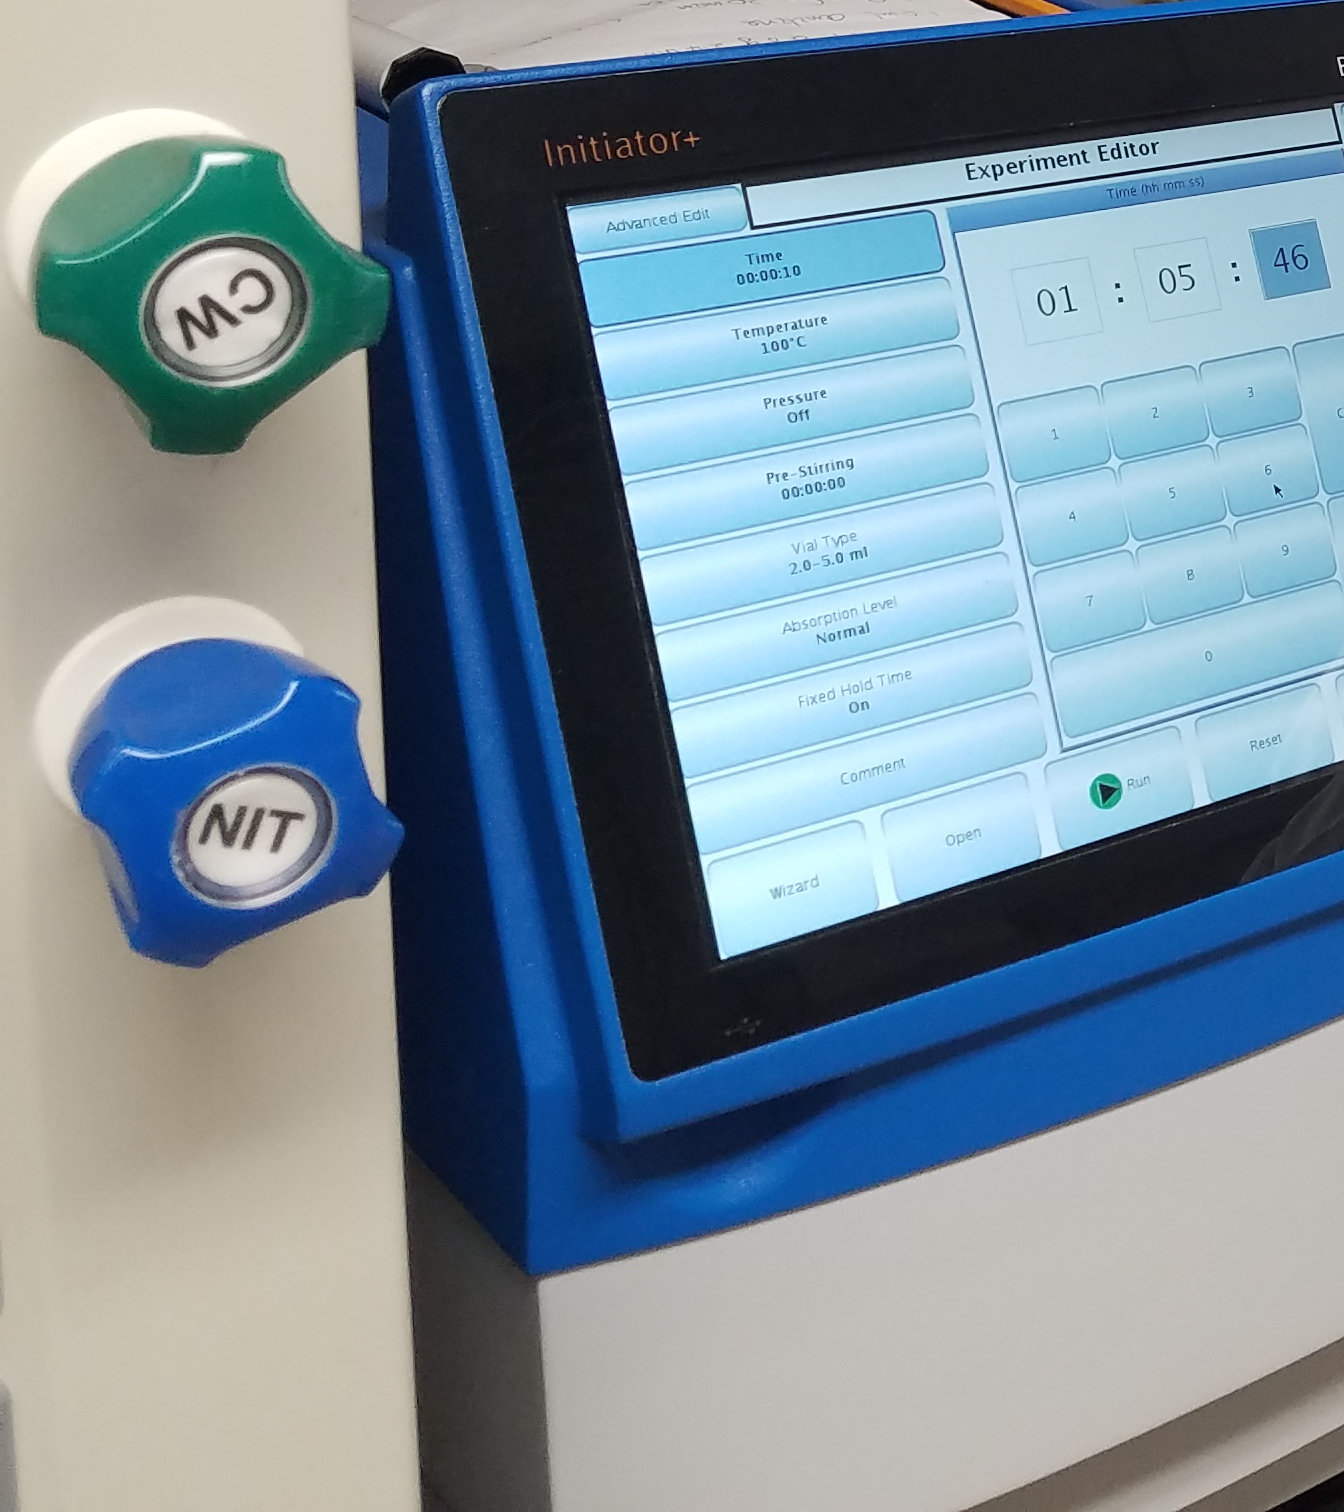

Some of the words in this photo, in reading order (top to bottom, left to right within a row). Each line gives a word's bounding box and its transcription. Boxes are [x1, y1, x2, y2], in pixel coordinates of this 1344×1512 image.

[544, 128, 701, 167] Initiator+
[965, 148, 1090, 182] Experiment
[1097, 138, 1160, 162] Editor
[1106, 187, 1137, 199] Time
[606, 210, 678, 233] Advanced
[683, 207, 710, 224] Edit
[745, 249, 783, 265] Time
[736, 264, 801, 286] 00:00:10
[1035, 285, 1080, 317] 01
[1157, 263, 1196, 294] 05
[1272, 243, 1310, 274] 46
[174, 267, 275, 351] CW
[732, 314, 828, 341] Temperature
[761, 336, 807, 355] 100°C
[763, 388, 827, 411] Pressure
[1247, 386, 1254, 398] 3
[787, 408, 811, 424] Off
[1151, 407, 1159, 419] 2
[1051, 429, 1059, 440] 1
[766, 456, 855, 485] Pre-Stirring
[1265, 465, 1272, 476] 6
[781, 477, 846, 501] 00:00:00
[1169, 487, 1176, 499] 5
[1069, 511, 1076, 522] 4
[791, 536, 818, 555] Vial
[824, 530, 858, 550] Type
[1282, 545, 1289, 556] 9
[789, 552, 844, 575] 2.0-5.0
[850, 546, 868, 561] ml
[1187, 569, 1194, 580] 8
[1086, 596, 1094, 607] 7
[782, 607, 858, 634] Absorption
[863, 595, 897, 615] Level
[816, 621, 870, 645] Normal
[1205, 650, 1213, 662] 0
[798, 688, 836, 709] Fixed
[841, 677, 873, 697] Hold
[879, 668, 912, 687] Time
[849, 698, 870, 714] On
[1250, 733, 1283, 752] Reset
[840, 758, 906, 786] Comment
[1128, 773, 1151, 790] Run
[199, 804, 305, 856] NIT
[945, 827, 982, 847] Open
[769, 875, 820, 900] Wizard
